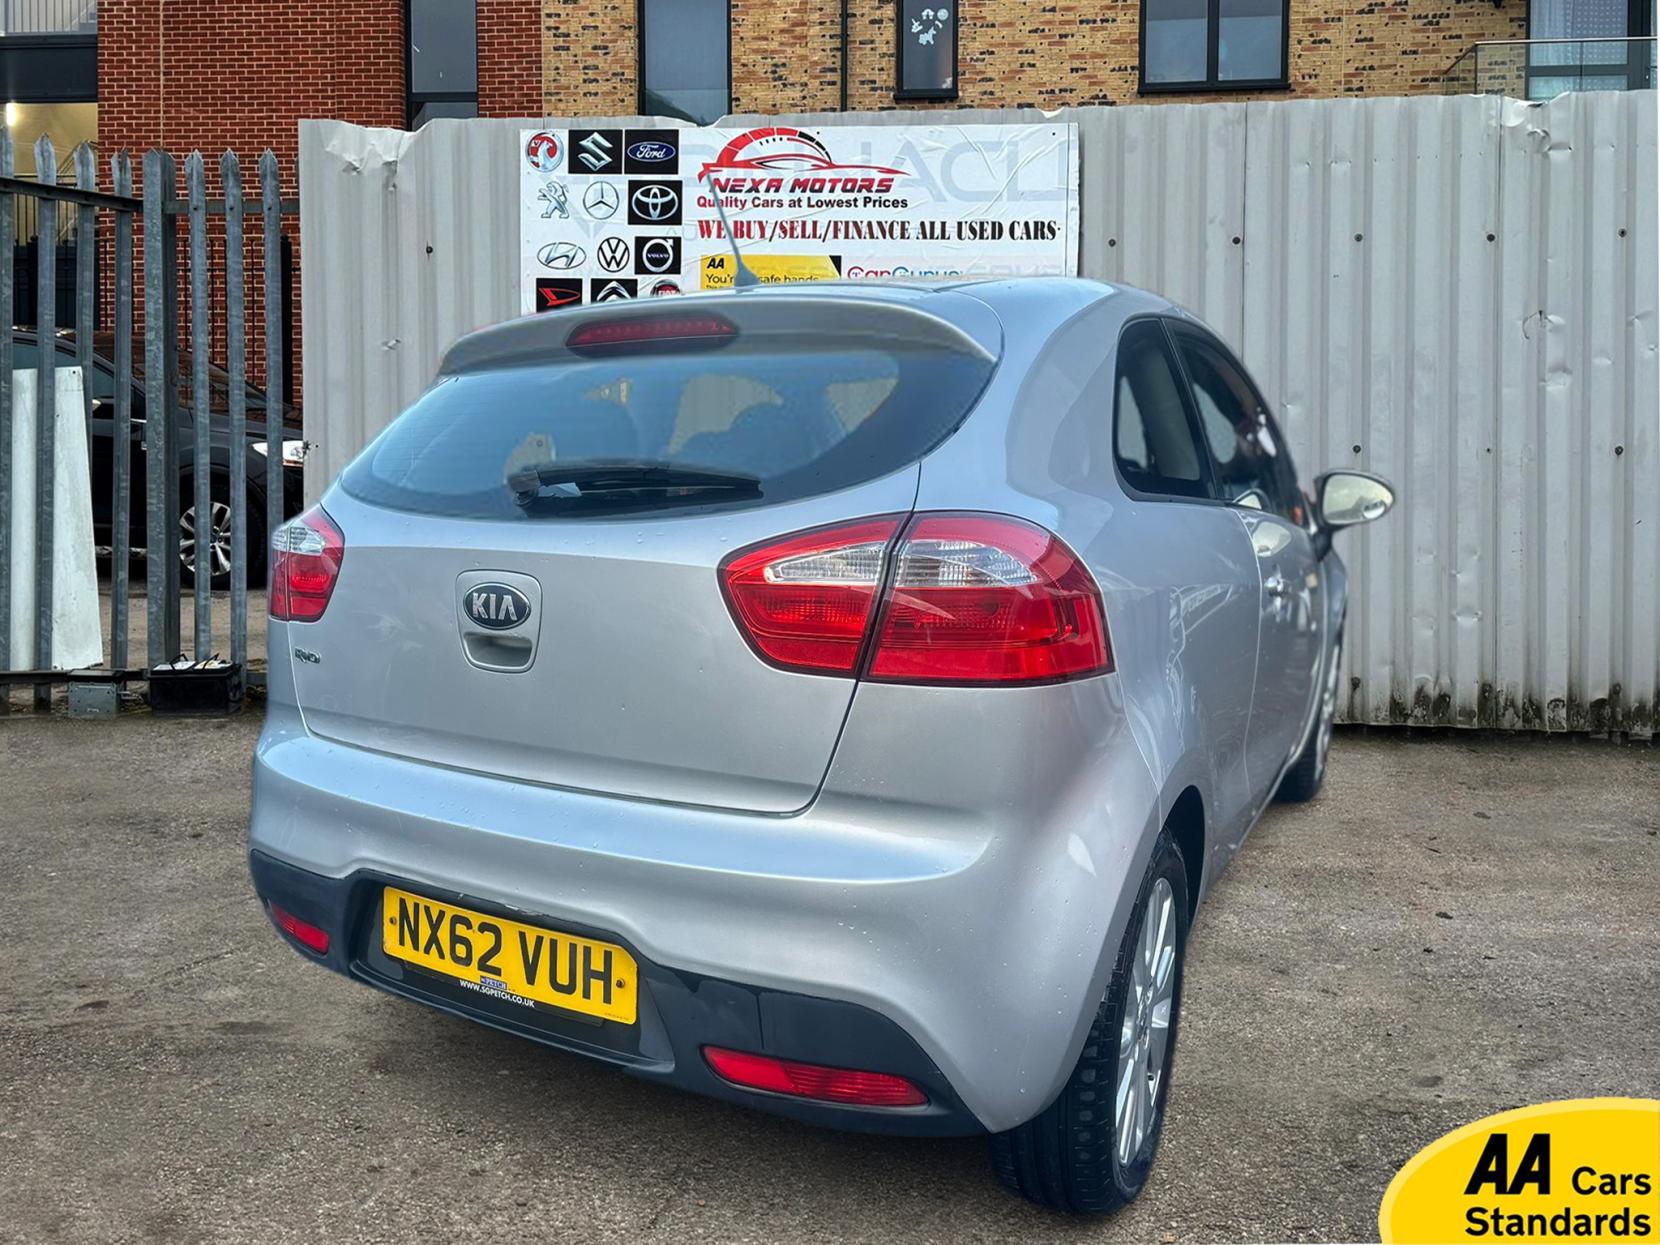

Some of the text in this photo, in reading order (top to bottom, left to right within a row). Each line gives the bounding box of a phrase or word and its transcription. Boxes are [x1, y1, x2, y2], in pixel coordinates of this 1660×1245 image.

[636, 144, 666, 159] Ford
[709, 178, 895, 193] NEXA MOTORS
[697, 196, 908, 210] Quality Cars at Lowest Prices
[697, 220, 727, 239] WE
[917, 220, 951, 240] ALL
[956, 220, 1004, 240] USED
[1008, 220, 1057, 240] CARS
[707, 258, 725, 269] AA
[472, 592, 518, 621] KIA
[399, 897, 613, 1005] NX62 VUH
